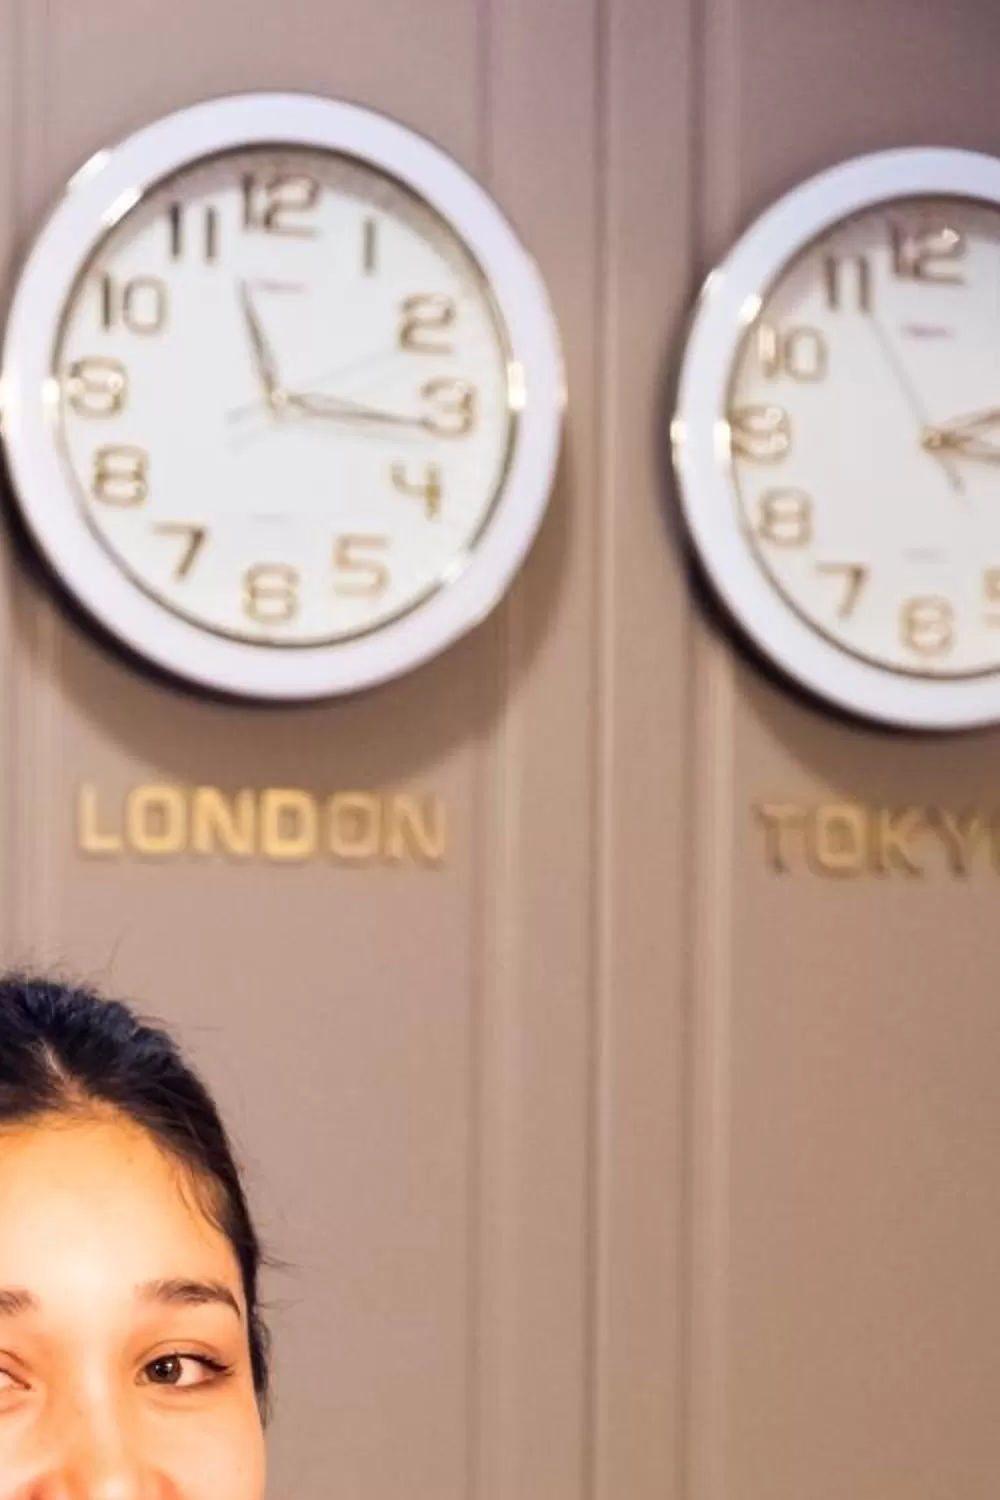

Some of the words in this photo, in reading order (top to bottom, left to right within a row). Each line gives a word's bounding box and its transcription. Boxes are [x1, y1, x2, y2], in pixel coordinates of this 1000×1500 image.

[167, 201, 219, 266] 11
[241, 171, 320, 238] 12
[361, 217, 377, 276] 1
[887, 222, 968, 287] 12
[101, 271, 168, 337] 10
[824, 254, 873, 317] 11
[399, 292, 456, 355] 2
[757, 322, 828, 383] 10
[67, 355, 128, 419] 9
[419, 377, 479, 439] 3
[91, 445, 149, 508] 8
[390, 461, 443, 520] 4
[759, 487, 814, 548] 8
[151, 522, 209, 582] 7
[332, 534, 389, 599] 5
[242, 562, 300, 625] 6
[816, 562, 870, 621] 7
[899, 594, 958, 657] 6
[77, 783, 448, 867] LONDON
[752, 801, 1000, 877] TOKY
